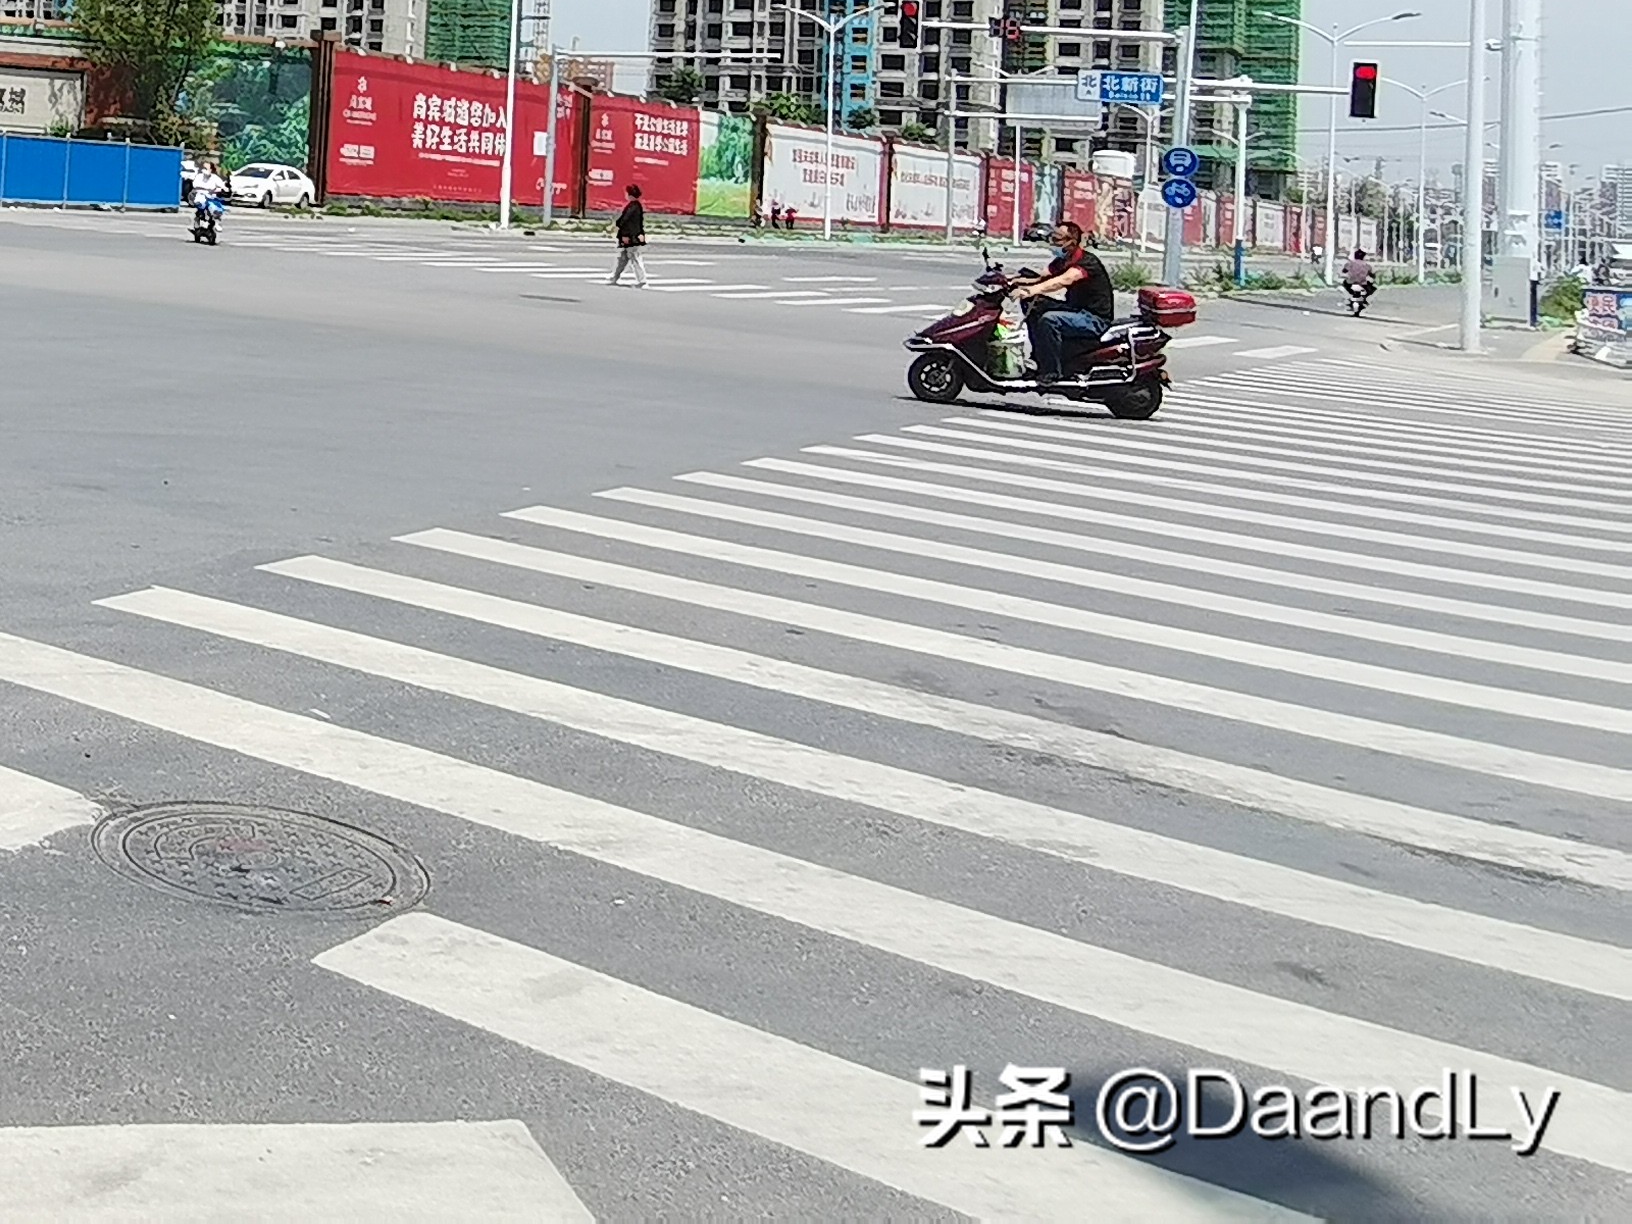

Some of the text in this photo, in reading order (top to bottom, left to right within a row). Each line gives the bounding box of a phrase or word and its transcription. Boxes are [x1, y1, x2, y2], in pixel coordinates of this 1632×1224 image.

[1081, 75, 1097, 88] 北
[1102, 75, 1158, 93] 北新街
[413, 92, 507, 129] 尚宾城邀您加入
